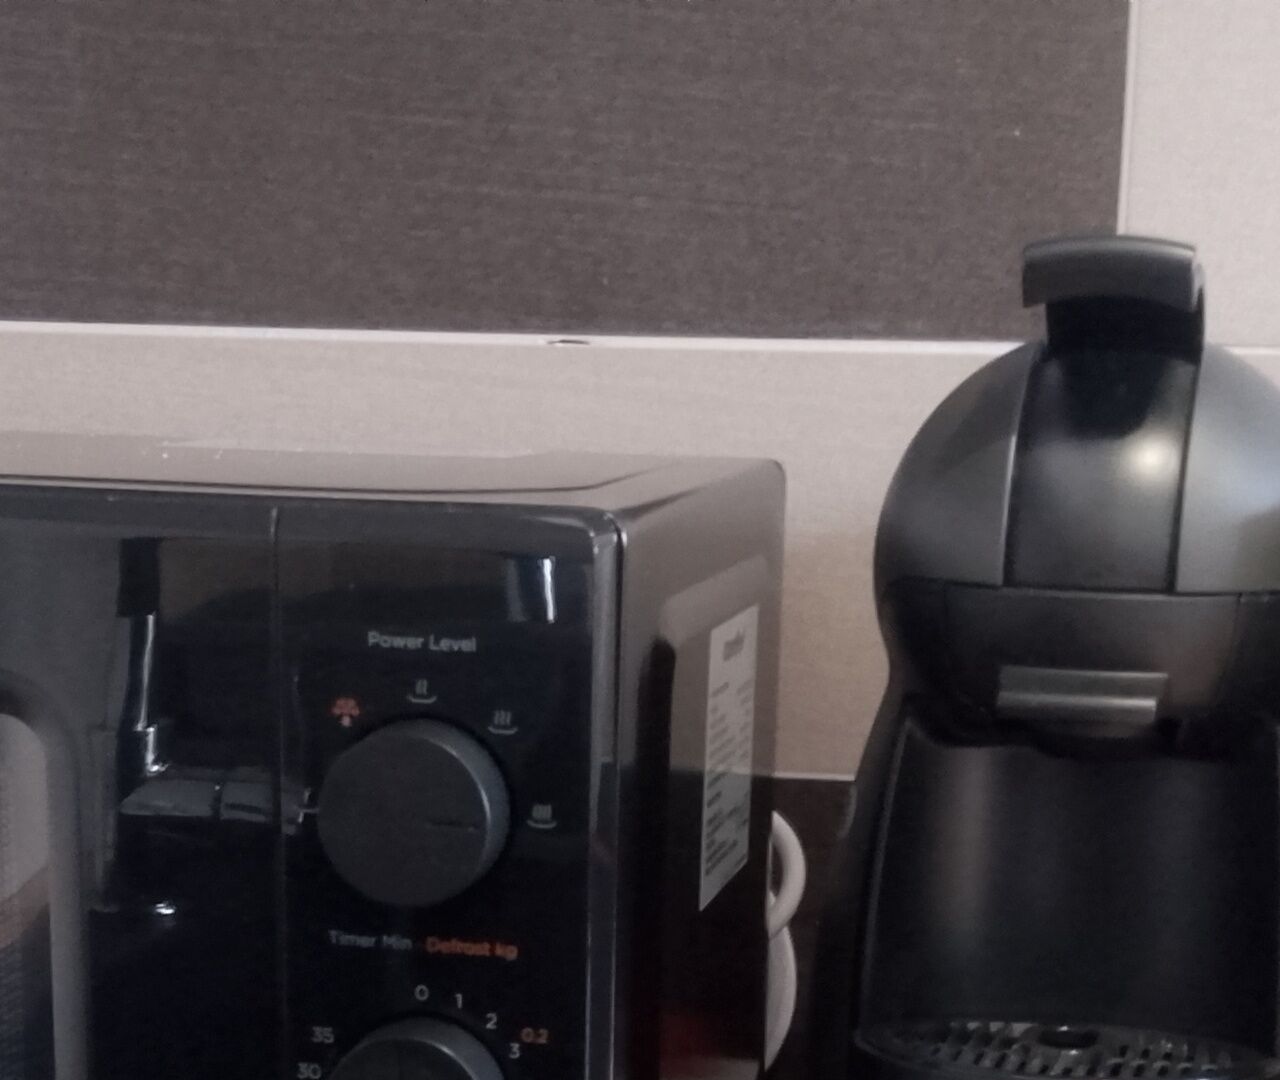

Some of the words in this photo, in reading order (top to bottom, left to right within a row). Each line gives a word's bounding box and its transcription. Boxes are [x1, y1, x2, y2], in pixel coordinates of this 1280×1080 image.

[368, 630, 424, 649] Power
[429, 634, 476, 652] Level
[328, 929, 376, 948] Timer
[383, 933, 413, 950] Min
[414, 984, 429, 1001] 0
[455, 993, 463, 1009] 1
[485, 1013, 498, 1030] 2
[311, 1026, 335, 1044] 35
[509, 1043, 520, 1059] 3
[297, 1062, 321, 1080] 30
